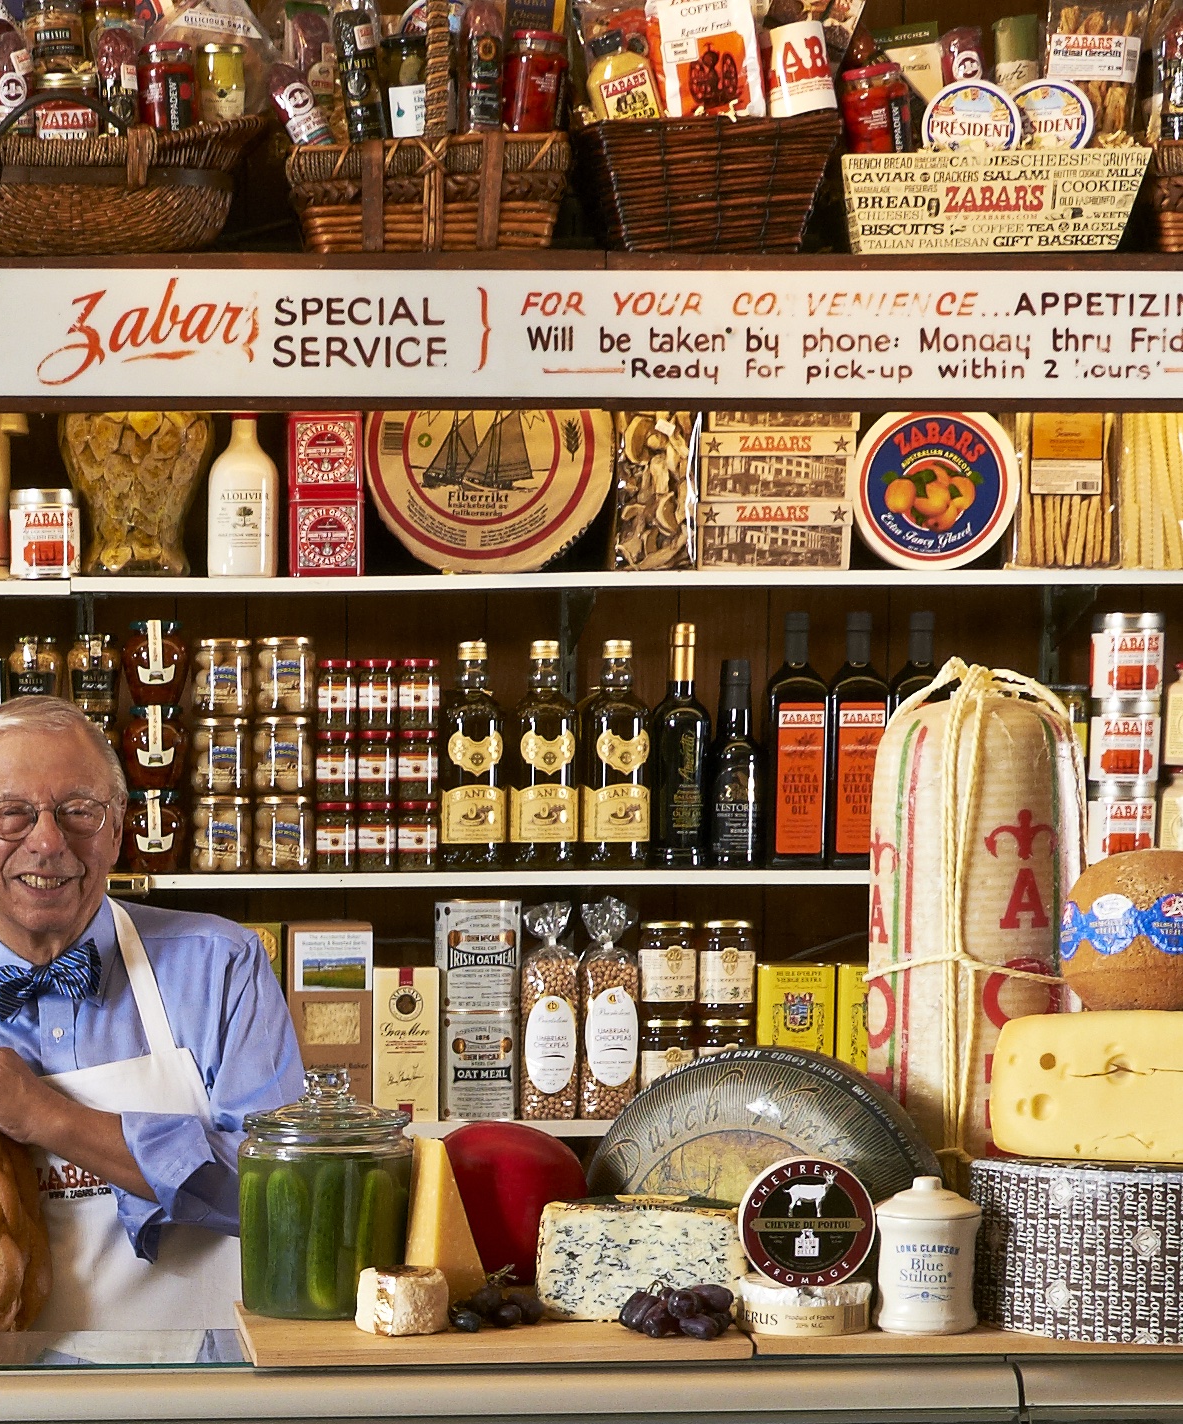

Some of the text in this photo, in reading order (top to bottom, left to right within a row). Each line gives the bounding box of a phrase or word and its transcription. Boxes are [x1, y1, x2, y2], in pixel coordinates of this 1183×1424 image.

[680, 1, 727, 17] COFFEE
[930, 120, 1008, 140] PRÉSIDENT
[993, 234, 1120, 248] GIFT BASKETS
[273, 295, 445, 327] SPECIAL
[521, 292, 586, 317] FOR
[613, 292, 703, 317] YOUR
[272, 334, 448, 368] SERVICE
[527, 328, 575, 354] Will
[599, 328, 631, 354] be
[650, 328, 726, 354] taken
[746, 326, 779, 360] by
[803, 329, 899, 359] phone:
[920, 328, 1030, 360] Monday
[1052, 328, 1112, 354] thru
[745, 359, 786, 381] for
[806, 358, 912, 384] pick-up
[938, 358, 1025, 381] within
[1045, 359, 1060, 380] 2
[784, 774, 819, 784] EXTRA
[785, 794, 816, 805] OLIVE
[450, 948, 517, 968] IRISH OATMEAL
[456, 1069, 509, 1079] OAT MEAL
[749, 1164, 827, 1208] CHEVRE
[802, 1220, 816, 1230] DU
[818, 1220, 852, 1231] POITOU
[895, 1243, 961, 1255] LONG CLAWSON
[762, 1258, 851, 1286] FROMAGE
[911, 1257, 944, 1272] Blue
[898, 1269, 952, 1284] Stilton
